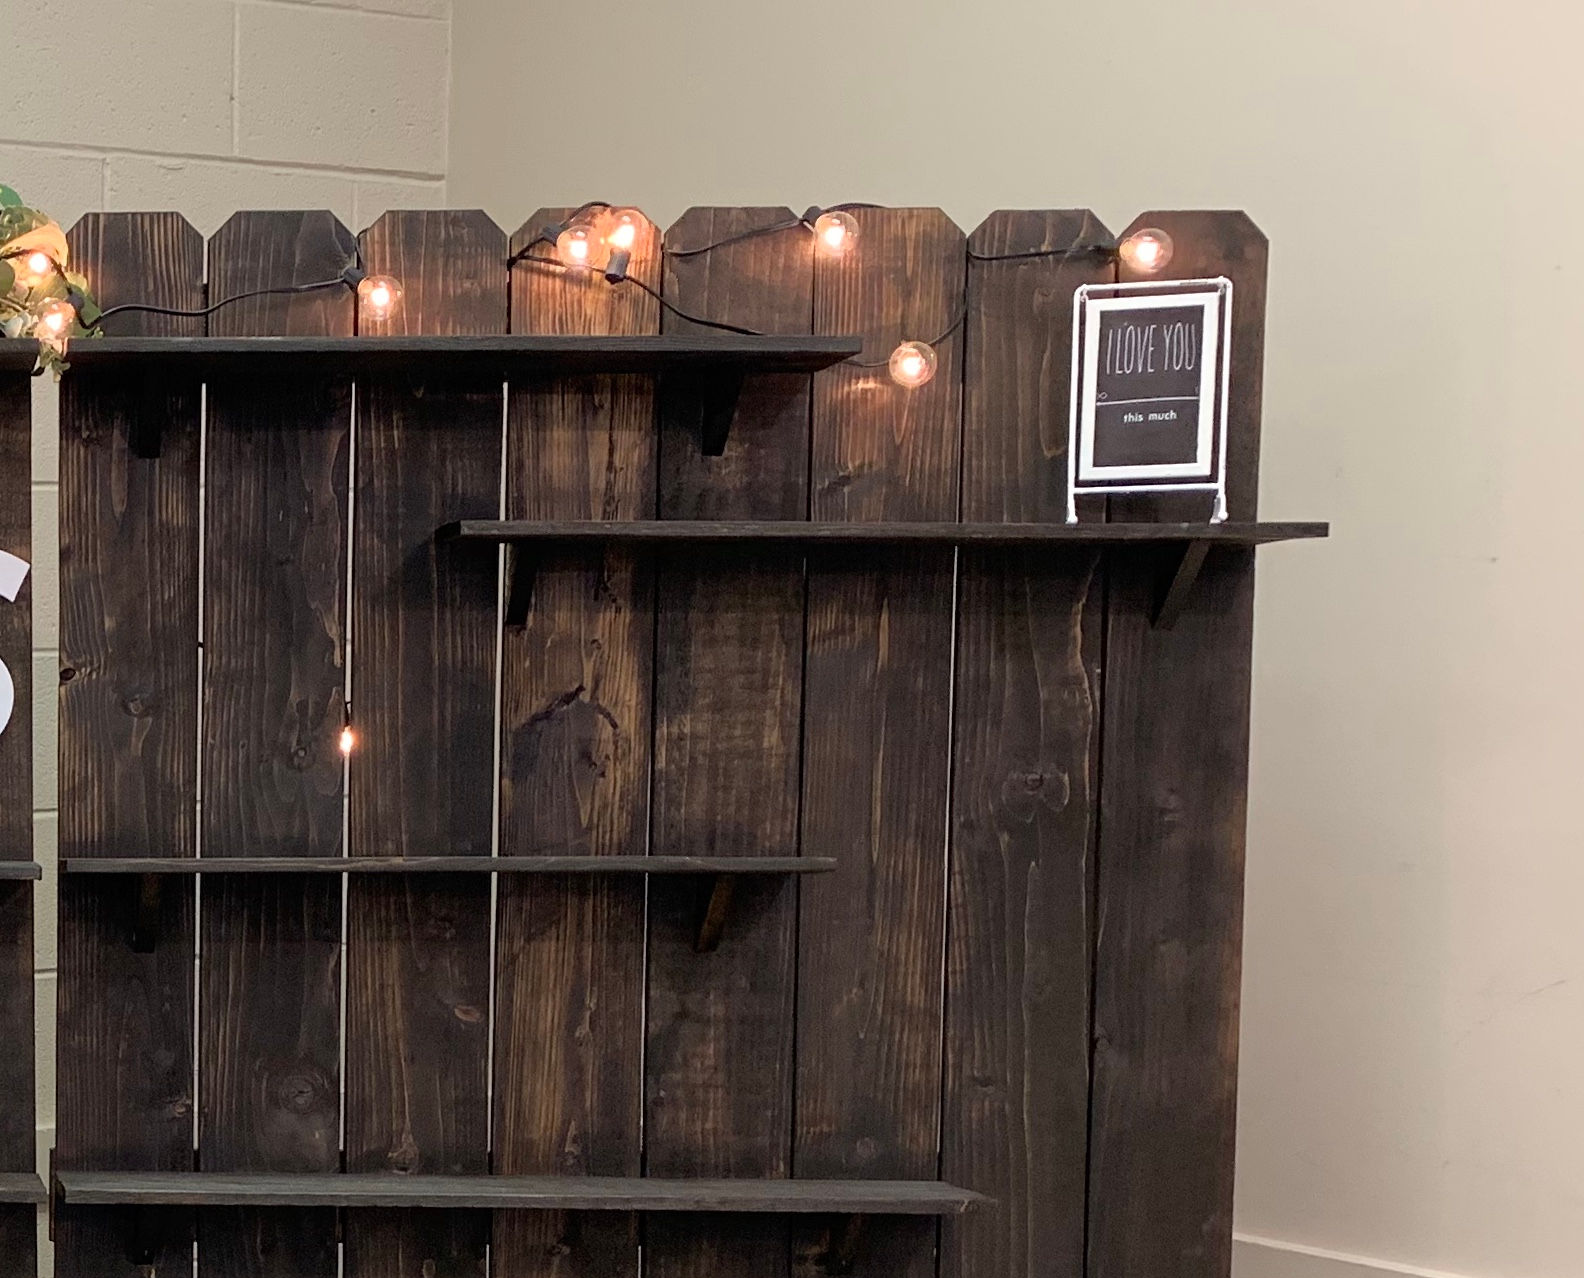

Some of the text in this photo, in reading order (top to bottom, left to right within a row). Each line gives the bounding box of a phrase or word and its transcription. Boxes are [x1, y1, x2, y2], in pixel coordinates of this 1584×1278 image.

[1106, 322, 1197, 375] I LOVE YOU
[1123, 410, 1177, 424] this much
